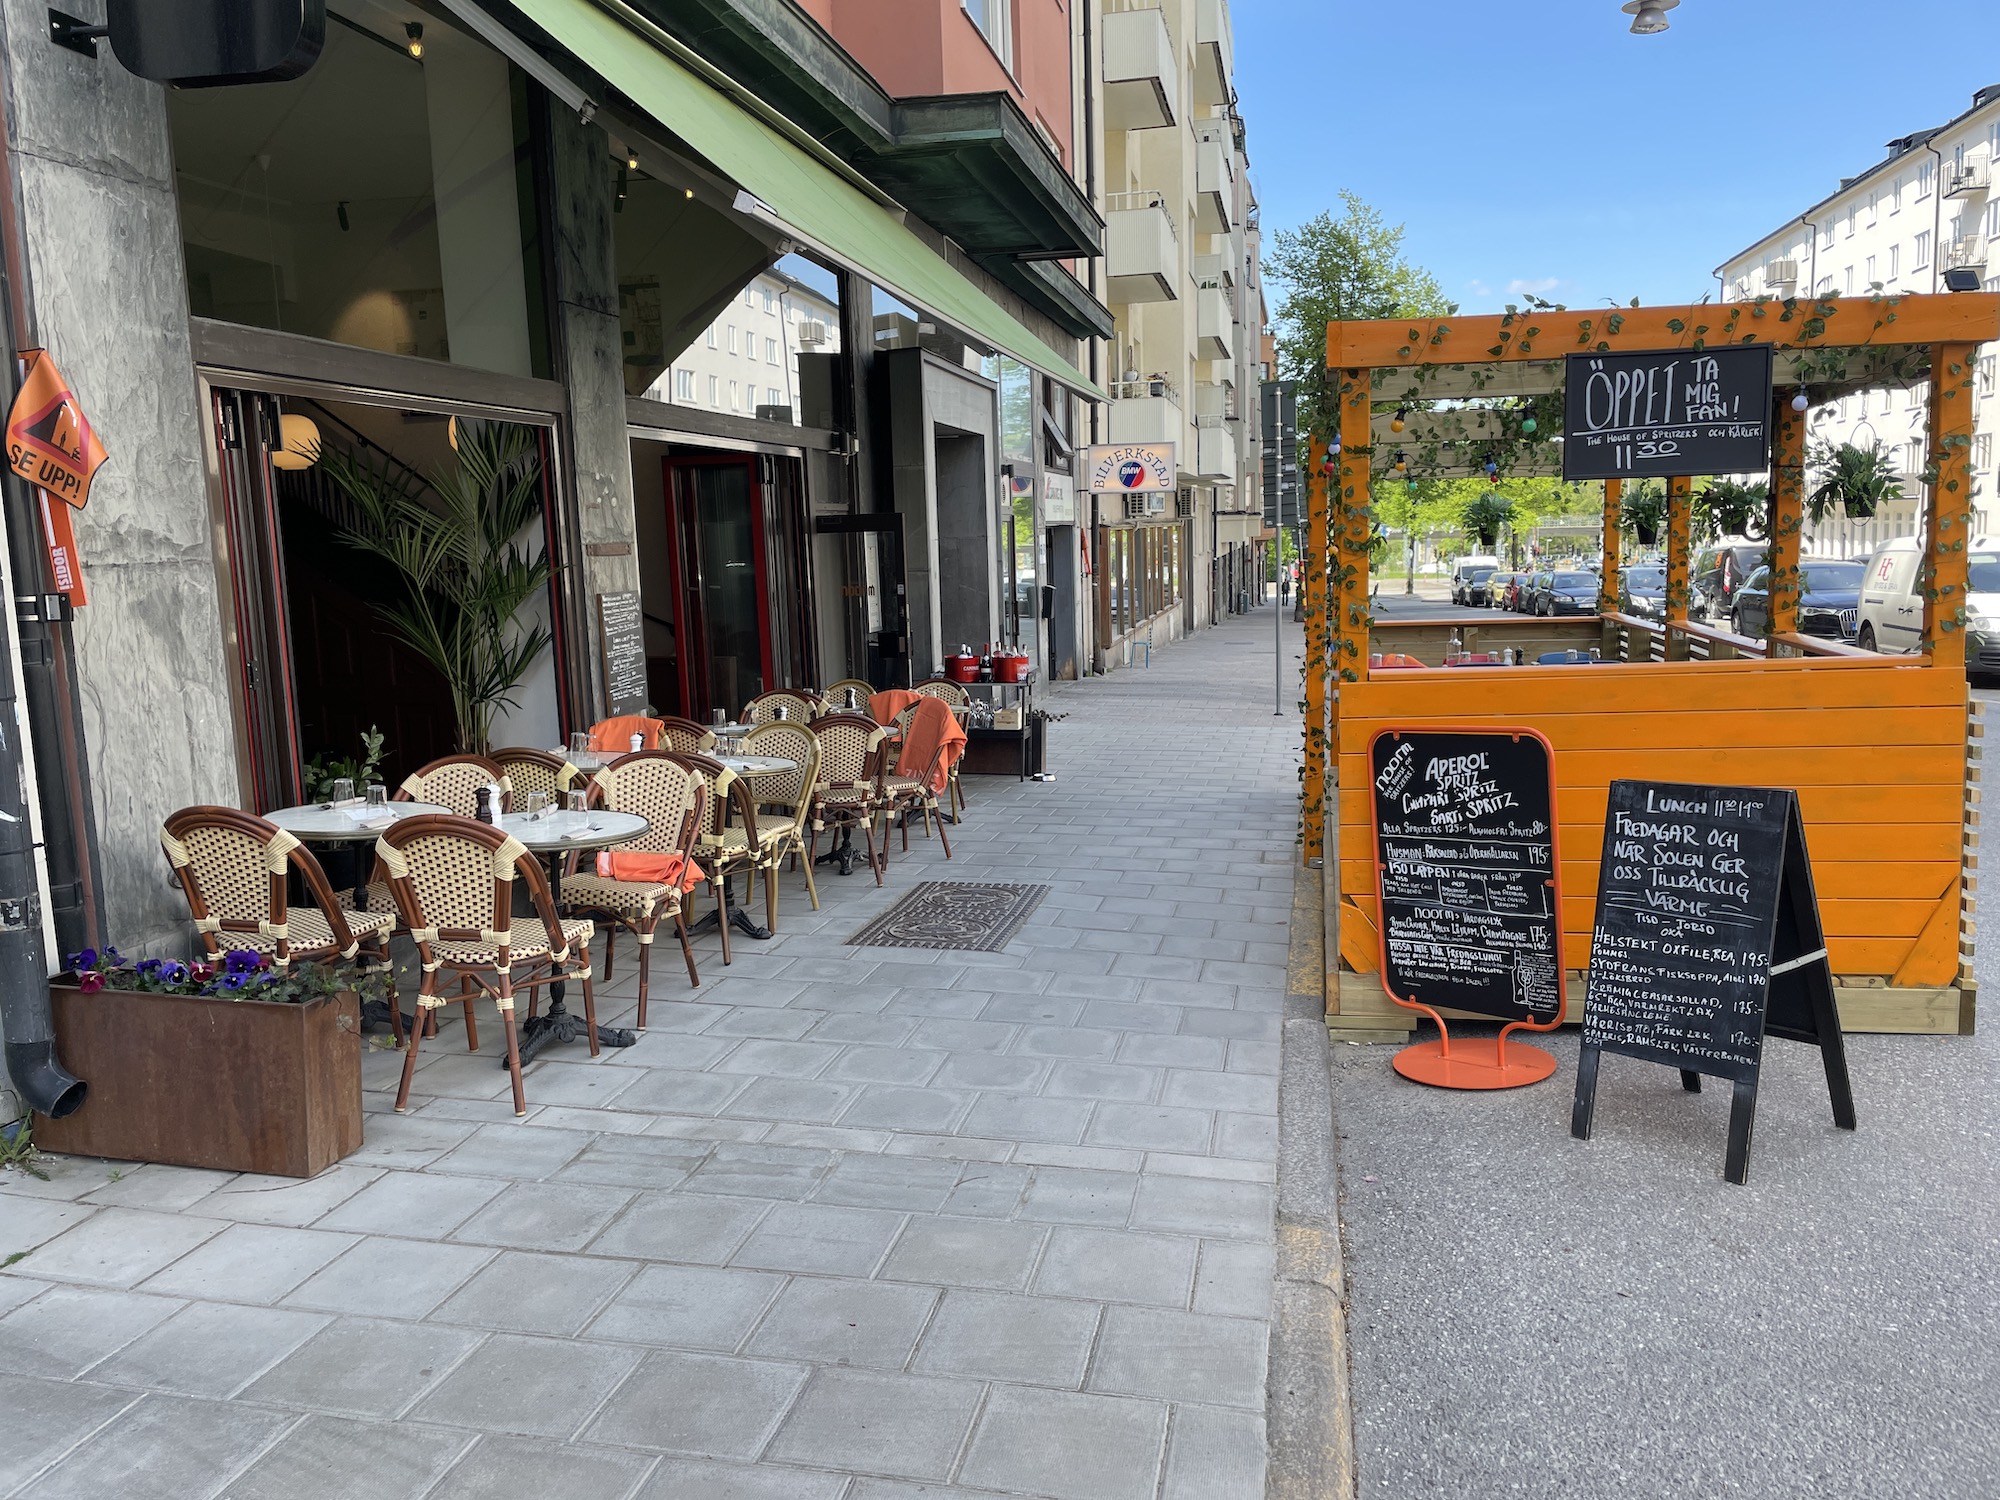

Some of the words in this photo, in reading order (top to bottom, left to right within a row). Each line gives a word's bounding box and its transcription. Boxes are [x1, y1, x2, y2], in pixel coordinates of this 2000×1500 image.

[1691, 356, 1719, 382] TA
[1586, 359, 1679, 430] ÖPPET
[1685, 382, 1720, 404] MIG
[1586, 437, 1603, 447] THE
[1607, 431, 1631, 443] HOUSE
[1636, 432, 1648, 441] OF
[1652, 429, 1698, 440] SPRITZERS
[1708, 428, 1725, 438] OCH
[10, 444, 37, 473] SE
[39, 459, 81, 499] UPP!
[1094, 447, 1170, 488] BILVERKSTAD
[1121, 466, 1141, 475] BMW
[1375, 742, 1415, 791] noorm
[1425, 752, 1489, 782] APEROL
[1437, 770, 1480, 791] SPRITZ
[1402, 789, 1449, 815] CAMPARI
[1454, 780, 1499, 803] SPRITZ
[1430, 805, 1463, 826] SARTI
[1465, 791, 1519, 819] SPRITZ
[1646, 789, 1707, 815] LUNCH
[1383, 822, 1402, 835] ALLA
[1615, 811, 1700, 846] FREDAGAR
[1707, 828, 1739, 852] OCH
[1389, 861, 1408, 875] 150
[1613, 840, 1649, 865] NÄR
[1652, 842, 1704, 868] SOLEN
[1711, 853, 1750, 879] GER
[1613, 865, 1643, 880] OSS
[1644, 889, 1711, 917] VÄRME
[1594, 925, 1658, 951] HELSTEKT
[1676, 919, 1715, 936] TORSD
[1446, 947, 1502, 963] FREDAGSLUNCH
